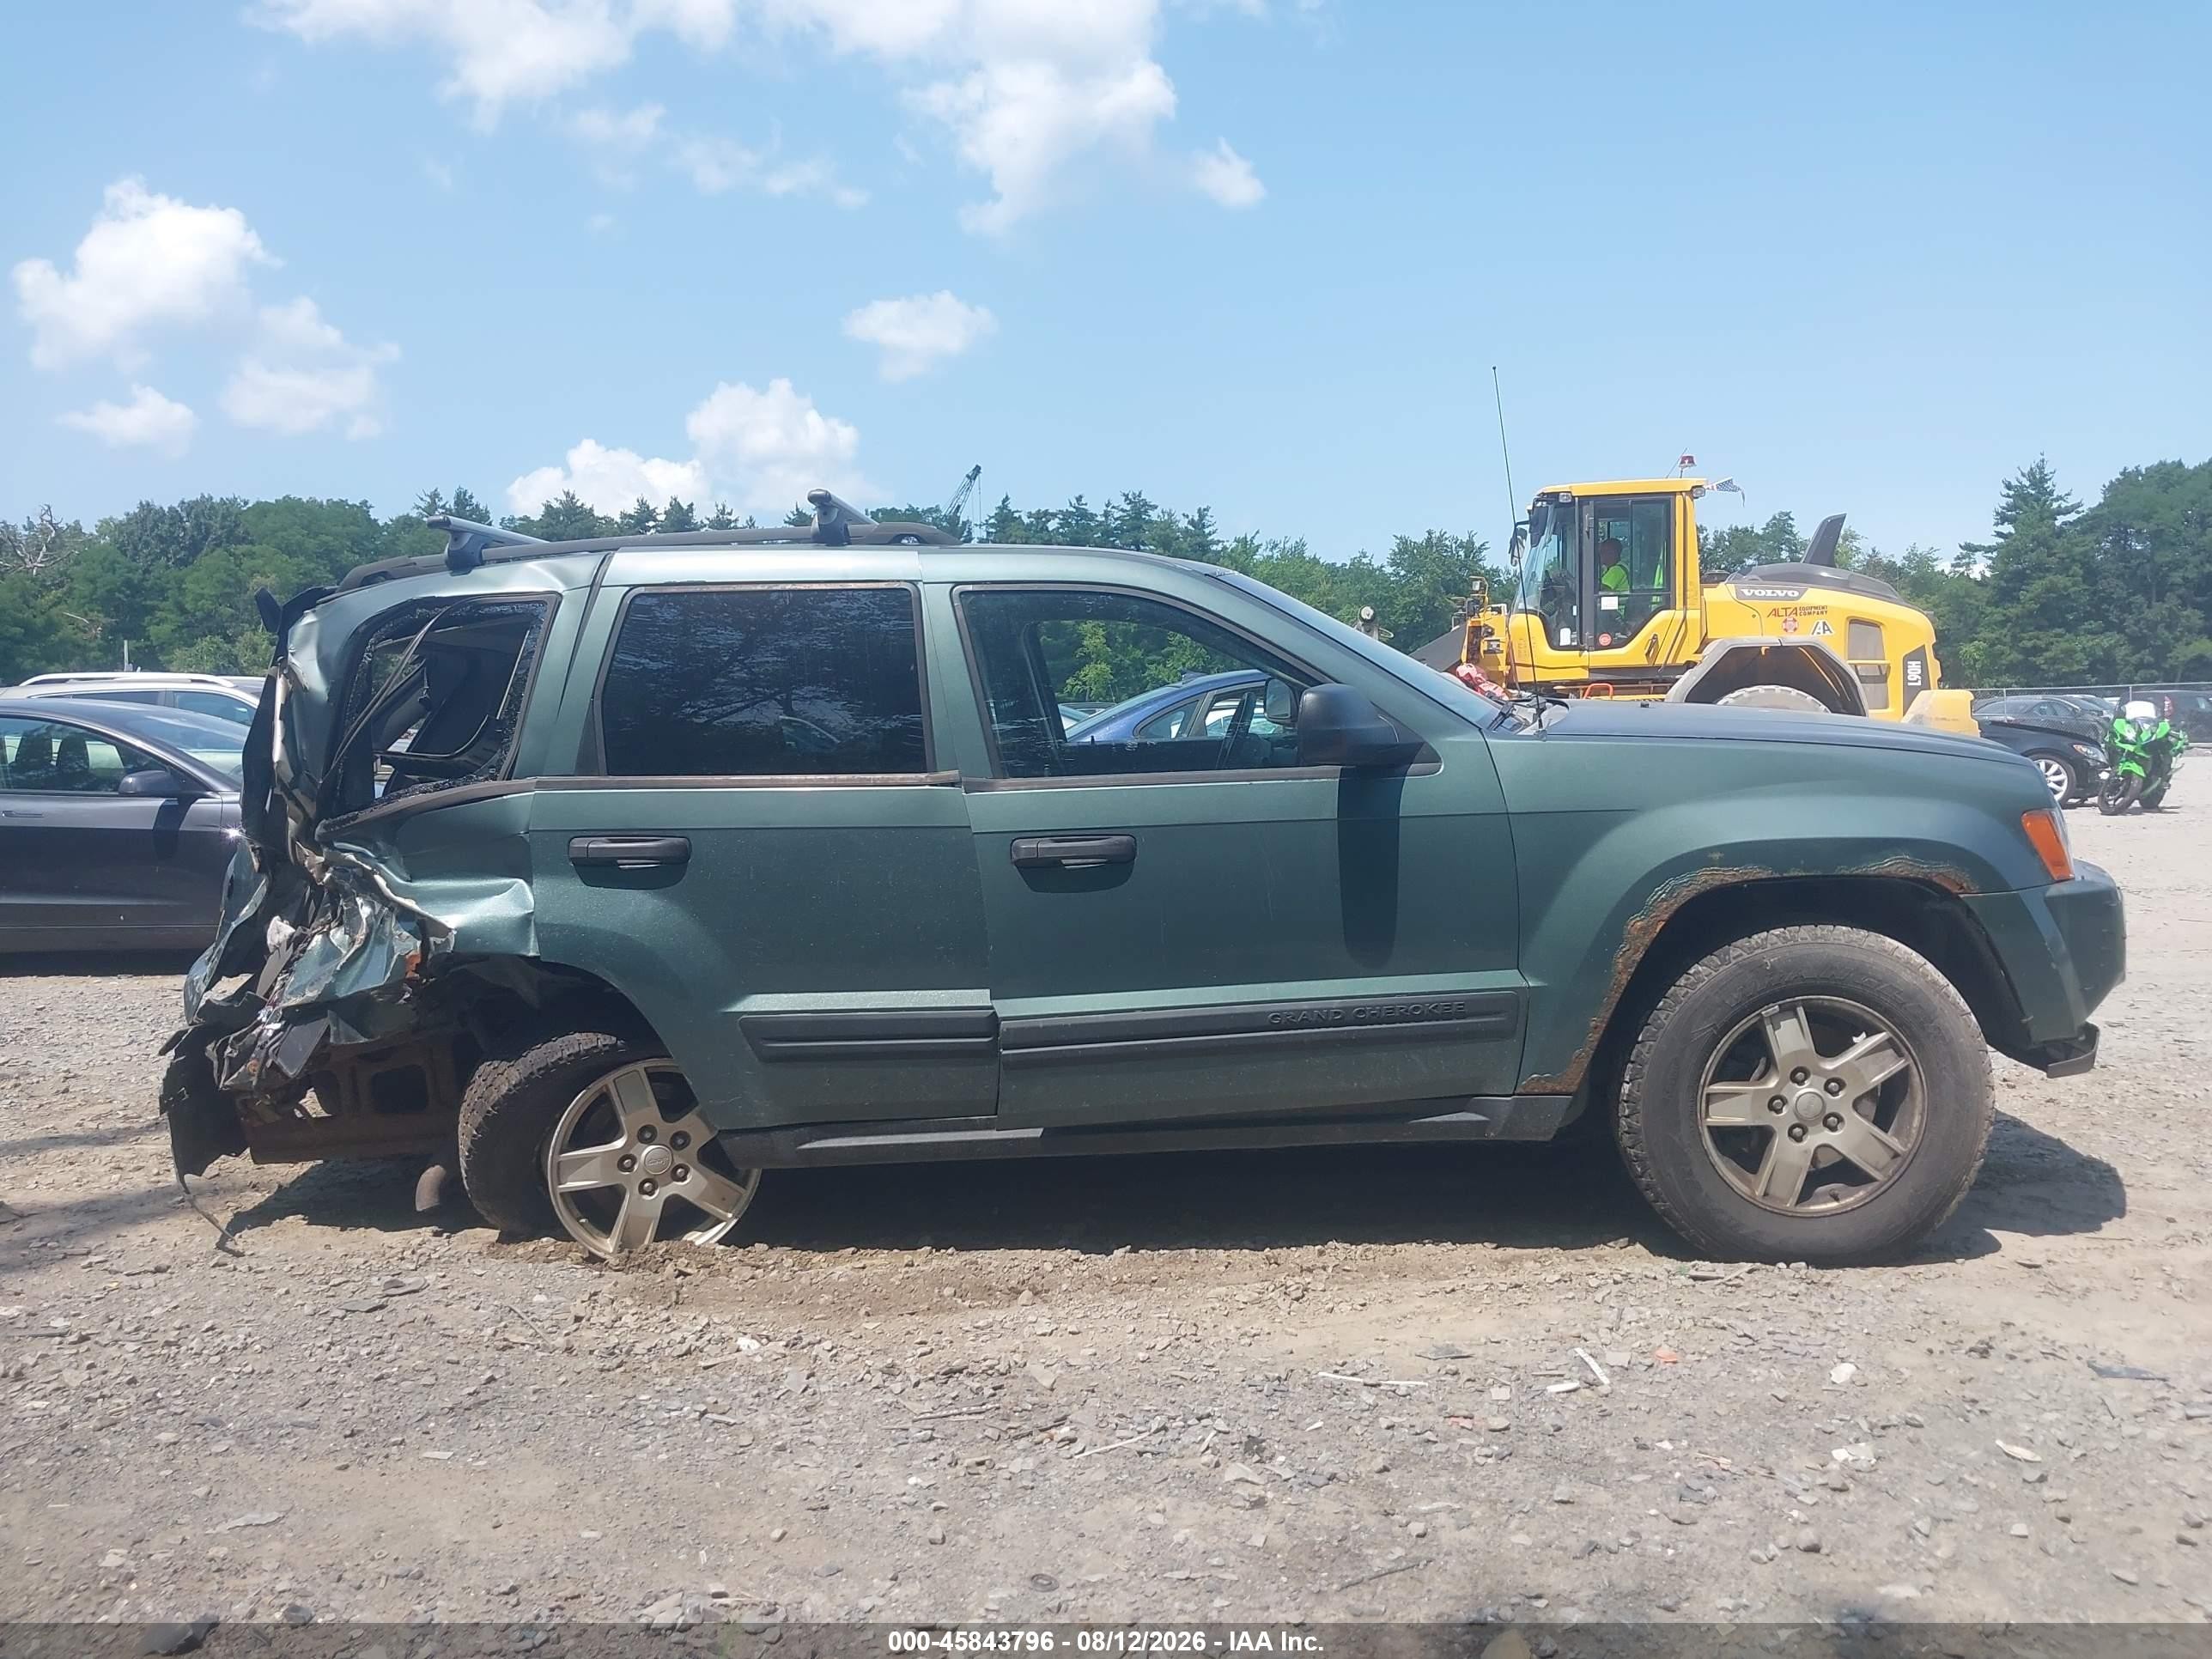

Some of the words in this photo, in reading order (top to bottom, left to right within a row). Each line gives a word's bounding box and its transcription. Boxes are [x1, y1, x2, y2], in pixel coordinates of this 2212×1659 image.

[1741, 588, 1800, 597] VOLVO
[1766, 606, 1799, 617] ALTA
[1907, 660, 1922, 686] L90H
[1267, 1008, 1346, 1025] GRAND
[1352, 1001, 1467, 1019] CHEROKEE
